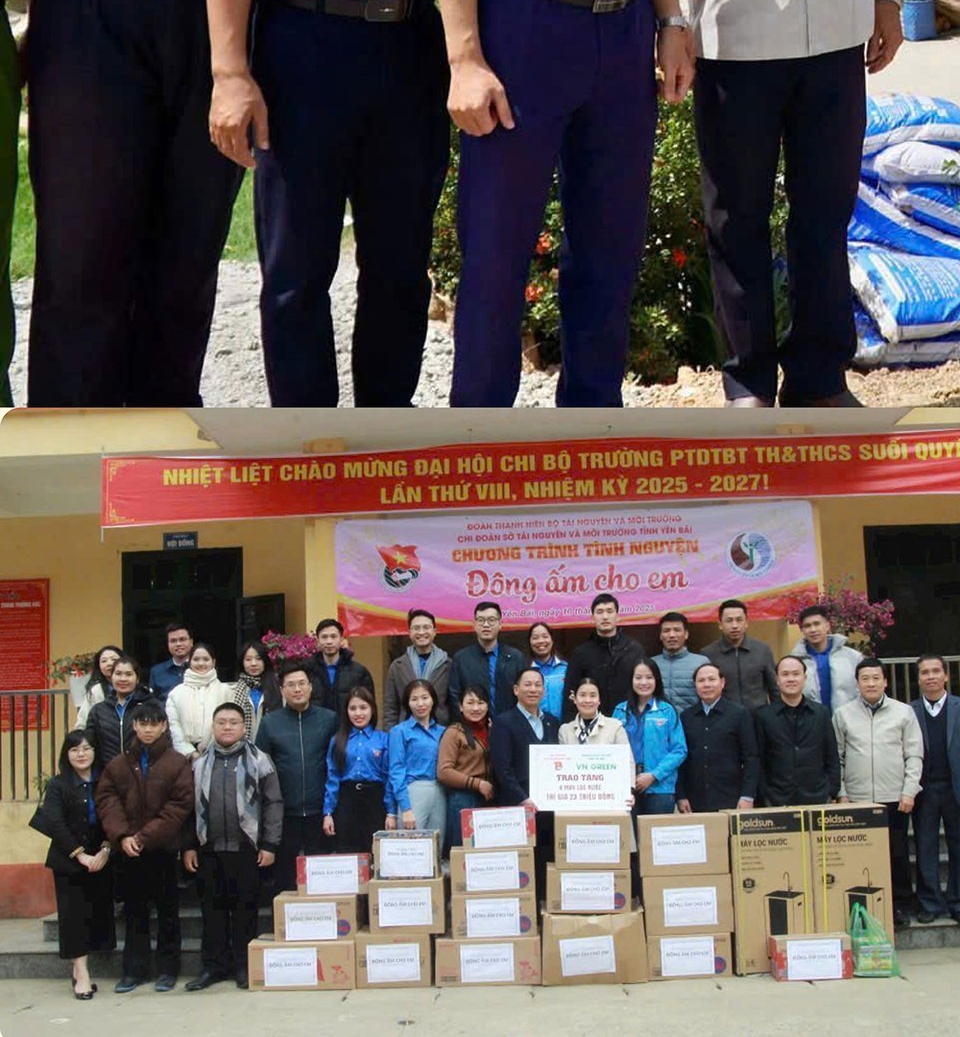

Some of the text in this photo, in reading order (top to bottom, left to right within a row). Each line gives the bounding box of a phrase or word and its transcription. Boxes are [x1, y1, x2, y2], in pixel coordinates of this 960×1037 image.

[163, 464, 223, 488] NHIỆT
[231, 463, 273, 486] LIỆT
[280, 460, 336, 481] CHÀO
[344, 457, 408, 478] MỪNG
[414, 458, 450, 479] ĐẠI
[457, 453, 494, 476] HỘI
[500, 454, 536, 472] CHI
[543, 450, 571, 474] BỘ
[578, 447, 664, 469] TRƯỜNG
[670, 448, 748, 466] PTDTBT
[755, 443, 852, 464] TH&THCS
[380, 481, 421, 504] LẦN
[428, 480, 472, 502] THỨ
[476, 483, 517, 501] VIII,
[524, 477, 594, 500] NHIỆM
[602, 475, 629, 495] KỲ
[636, 476, 688, 494] 2025
[710, 474, 769, 492] 2027!
[452, 538, 699, 562] CHƯƠNG TRÌNH TÌNH NGUYỆN
[457, 535, 473, 543] CHI
[466, 564, 688, 604] Đông ấm cho em
